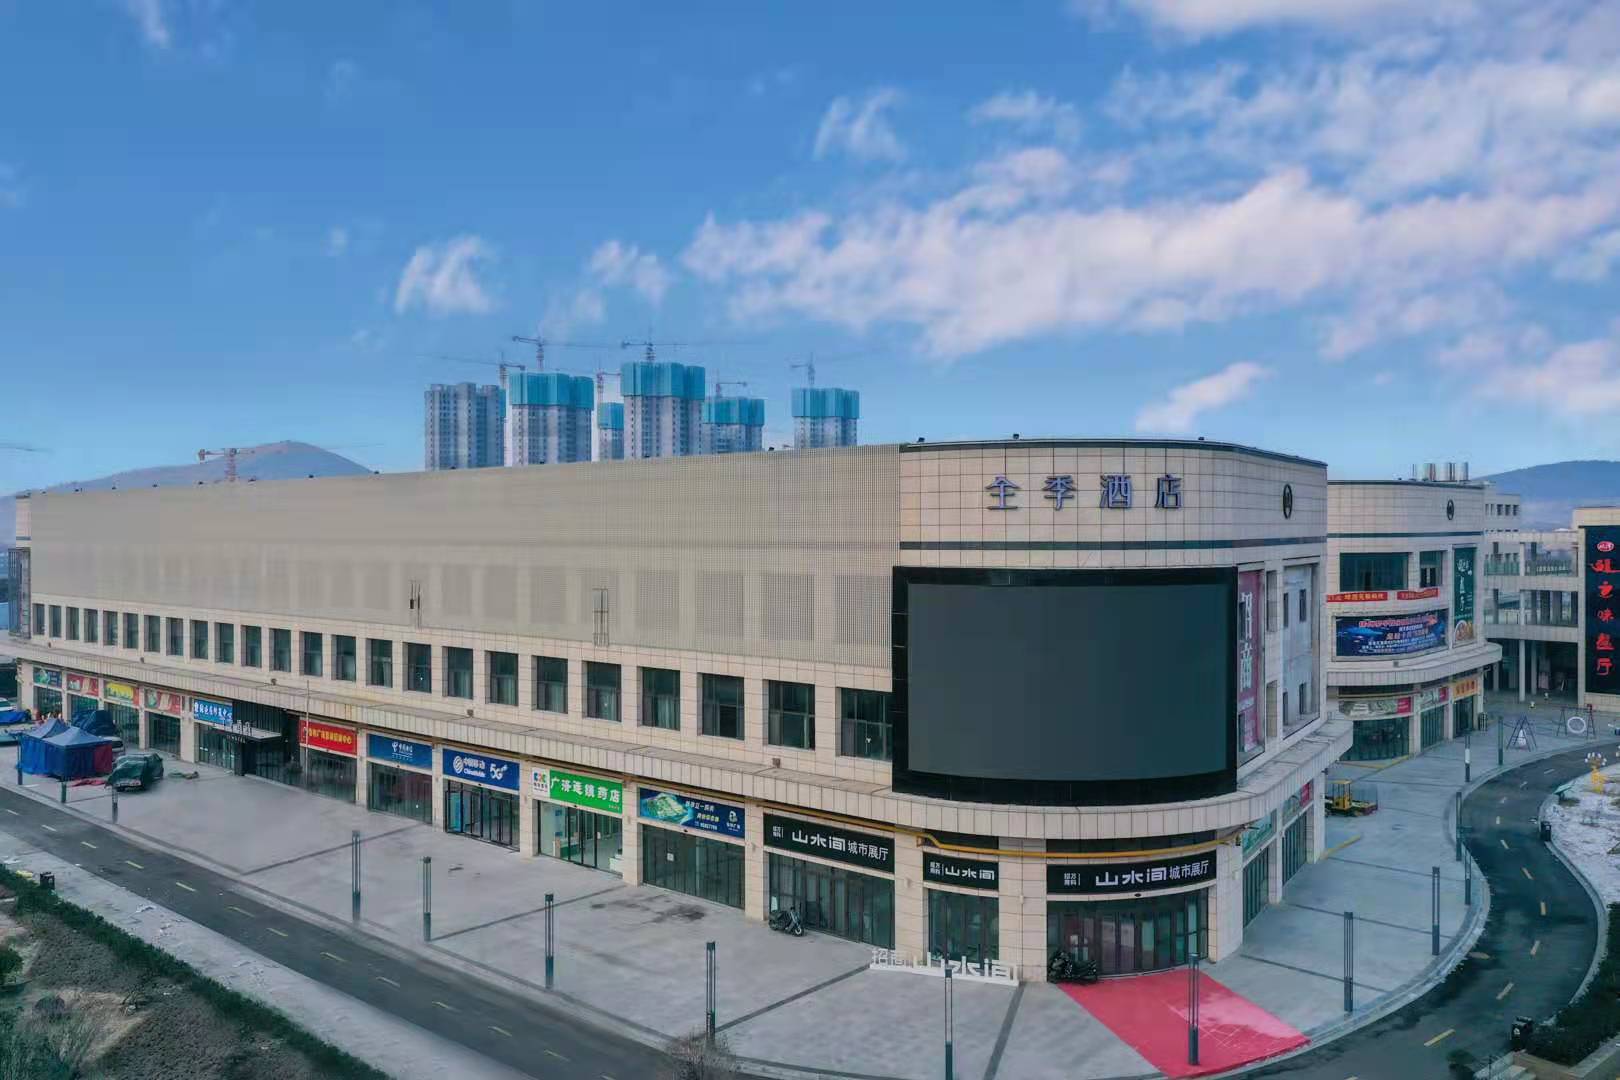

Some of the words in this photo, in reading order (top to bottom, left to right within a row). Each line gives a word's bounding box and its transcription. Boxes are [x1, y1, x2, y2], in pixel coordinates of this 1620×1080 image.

[985, 474, 1183, 511] 全季酒店
[945, 865, 995, 881] 山水间
